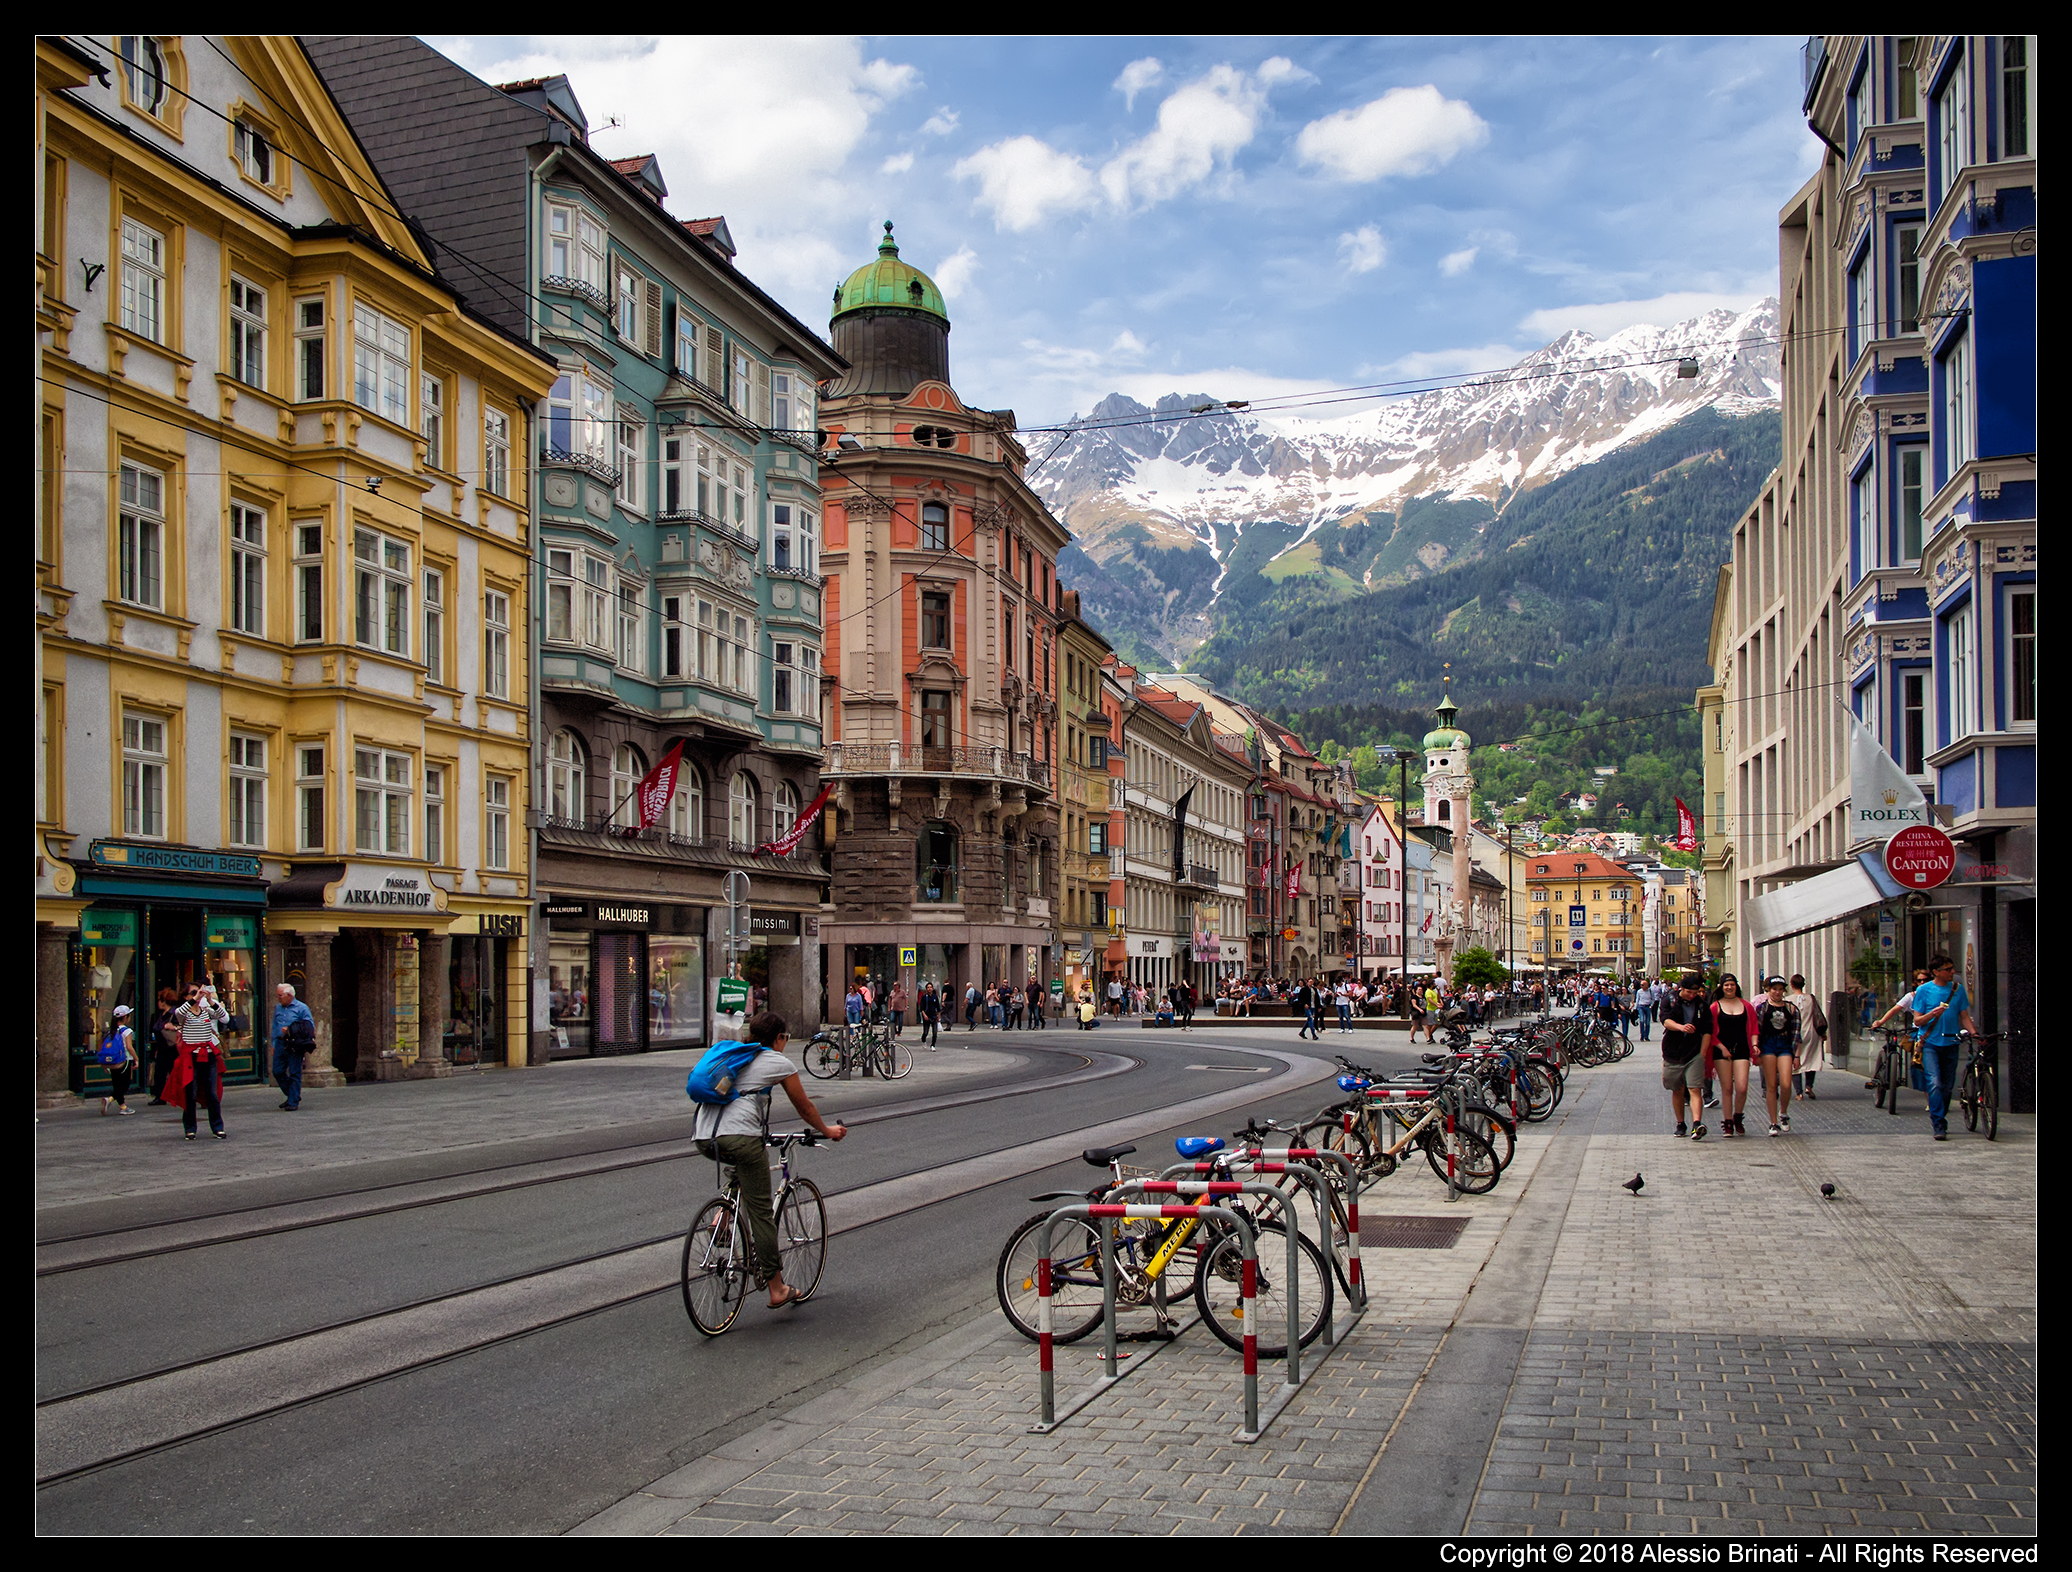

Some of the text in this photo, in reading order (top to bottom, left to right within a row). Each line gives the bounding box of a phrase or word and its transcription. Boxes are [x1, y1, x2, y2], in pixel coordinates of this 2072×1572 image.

[1860, 809, 1922, 821] ROLEX
[1895, 840, 1945, 848] RESTAURANT
[136, 851, 252, 872] HANDSCHUH BAER
[386, 878, 419, 889] PASSAGE
[344, 889, 431, 907] ARKADENHOF
[598, 907, 649, 923] HALLHUBER
[92, 923, 131, 932] HANDSCHUH
[478, 914, 523, 936] LUSH
[102, 931, 120, 940] BAER
[215, 928, 249, 936] HANDSCHUH
[223, 935, 240, 943] BAER
[1162, 1217, 1192, 1258] MERID
